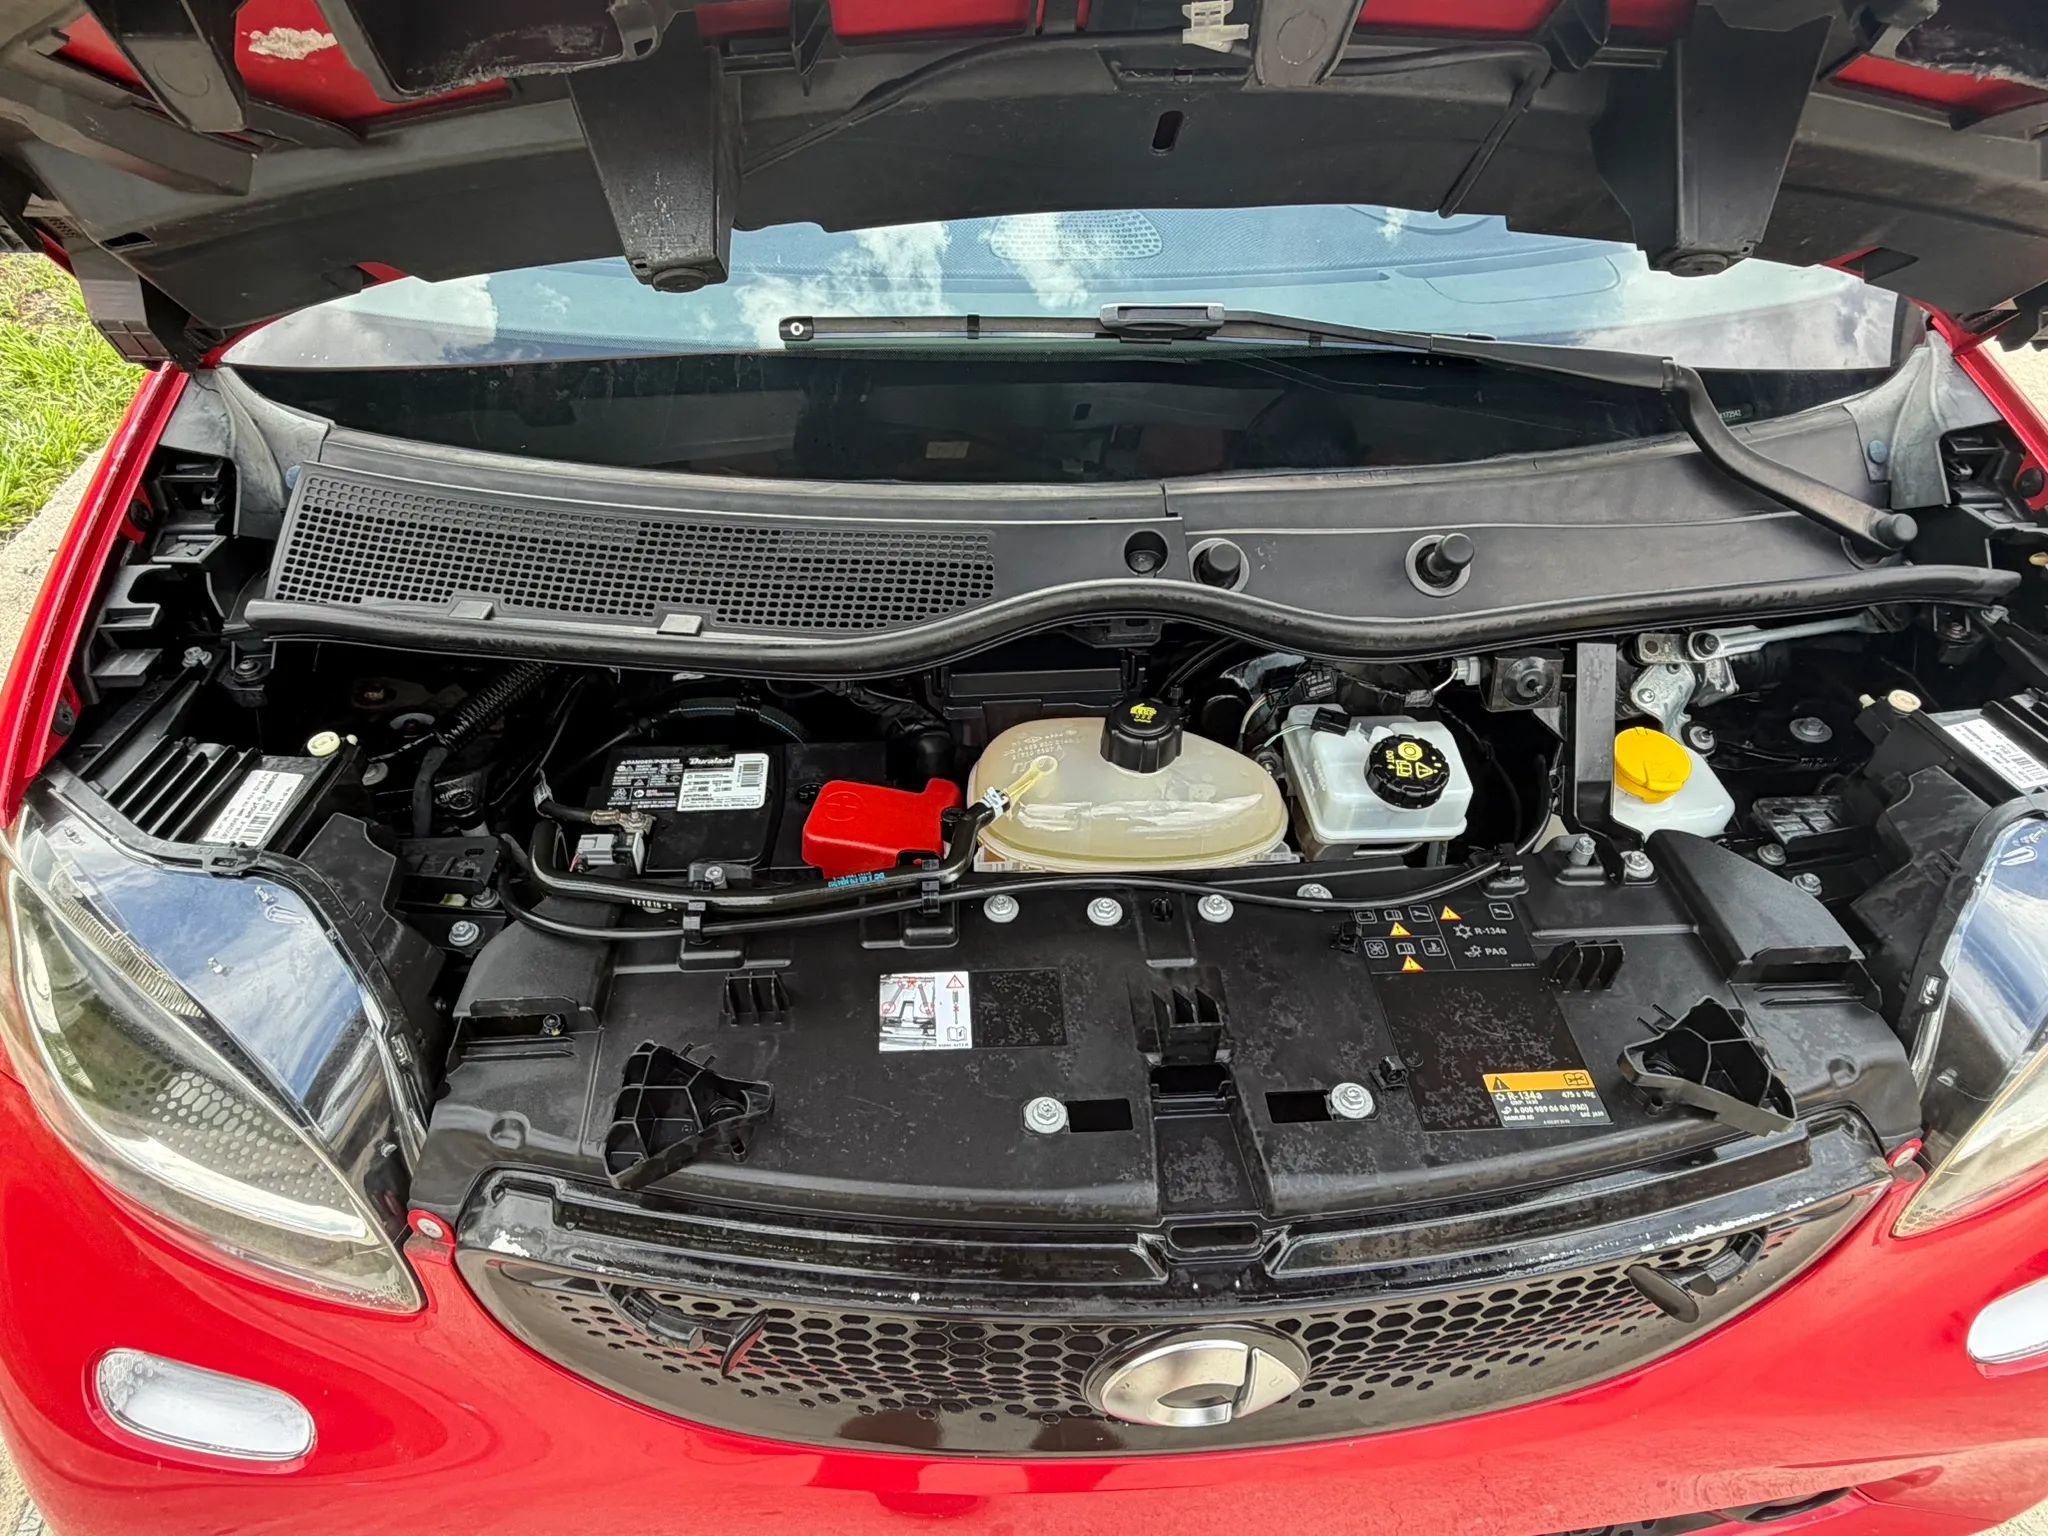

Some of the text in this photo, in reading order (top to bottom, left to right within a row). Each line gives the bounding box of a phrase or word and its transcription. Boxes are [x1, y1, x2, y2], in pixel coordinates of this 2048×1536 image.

[688, 757, 734, 766] Duralast
[1385, 750, 1395, 764] DOT
[1474, 926, 1508, 935] R-134a
[1484, 947, 1508, 956] PAG
[1508, 1091, 1543, 1101] R-134a
[1570, 1103, 1589, 1112] (PAG)
